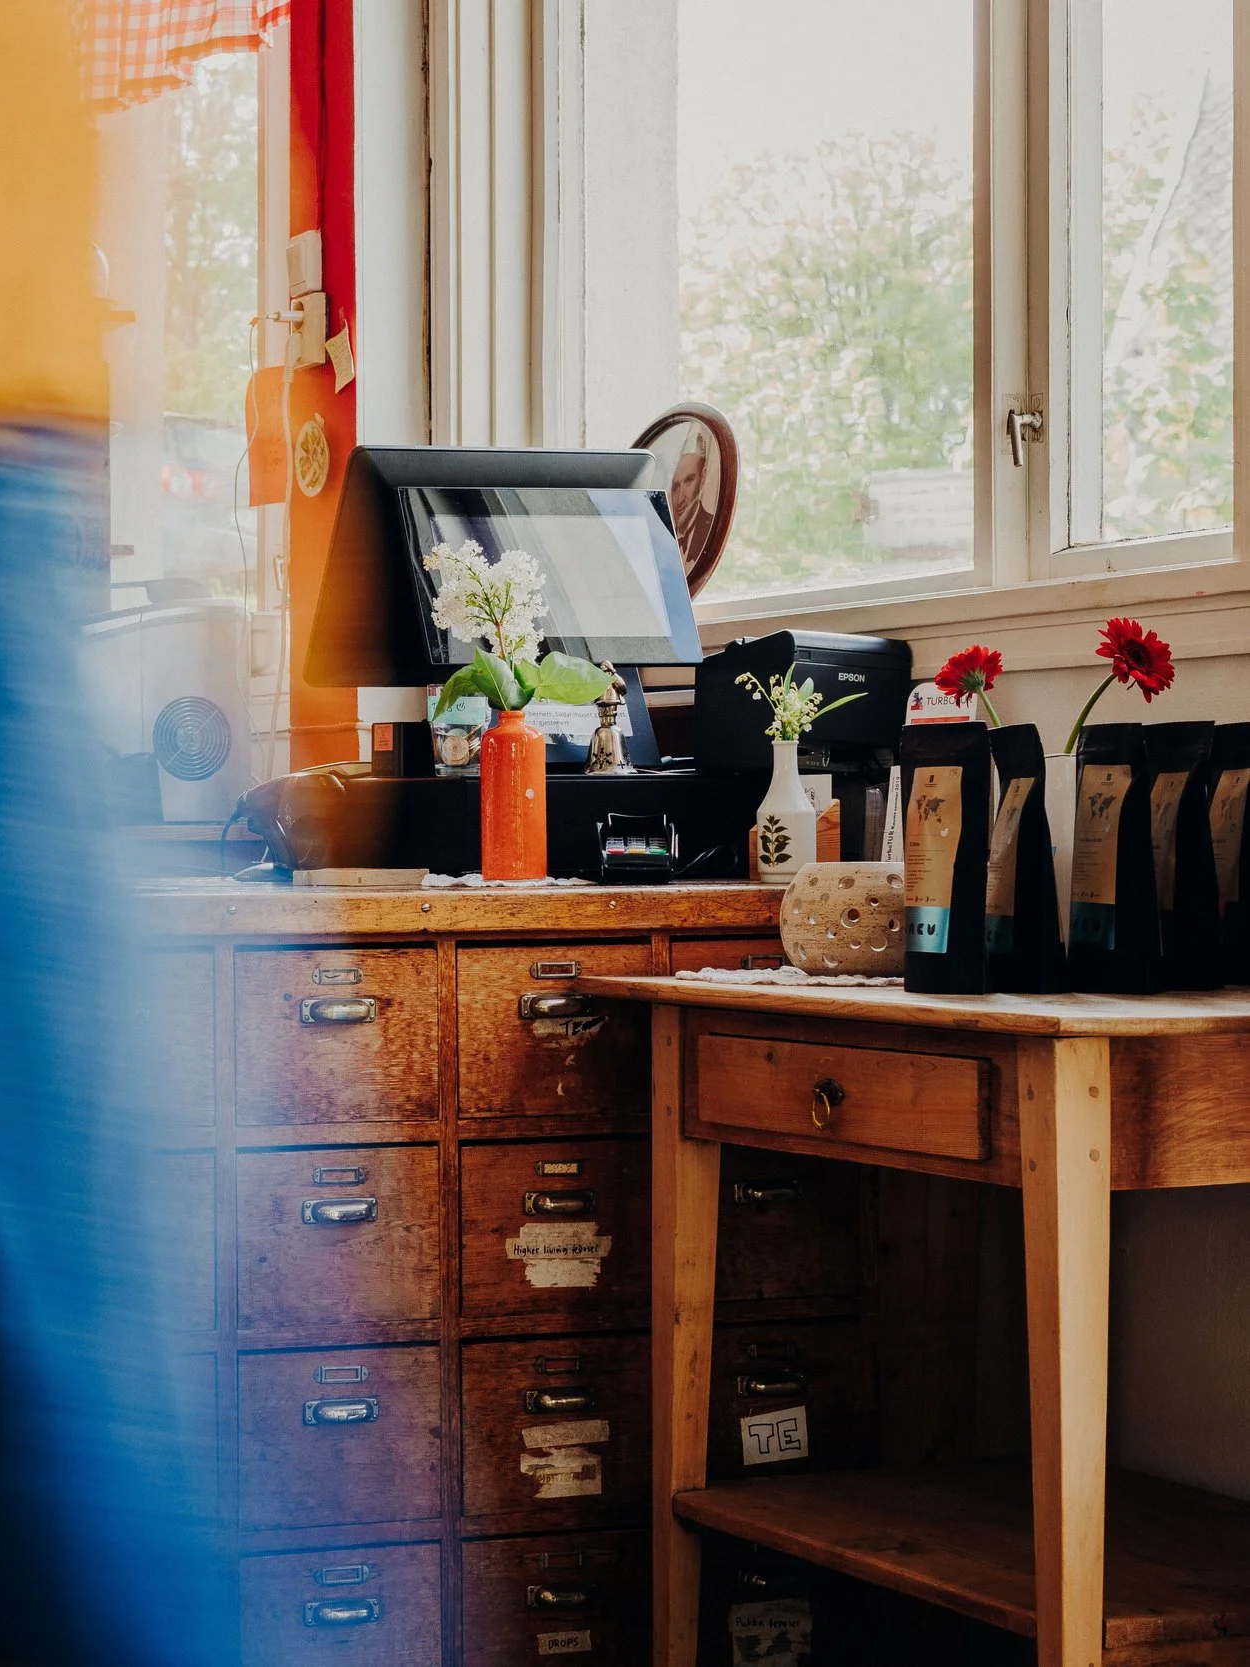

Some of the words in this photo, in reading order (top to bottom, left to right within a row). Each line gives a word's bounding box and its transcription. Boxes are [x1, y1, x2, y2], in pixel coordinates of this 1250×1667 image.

[838, 673, 865, 682] EPSON
[926, 696, 973, 706] TURBOUR
[513, 1243, 539, 1257] Higher
[748, 1417, 801, 1454] TE
[548, 1636, 579, 1650] DROPS
